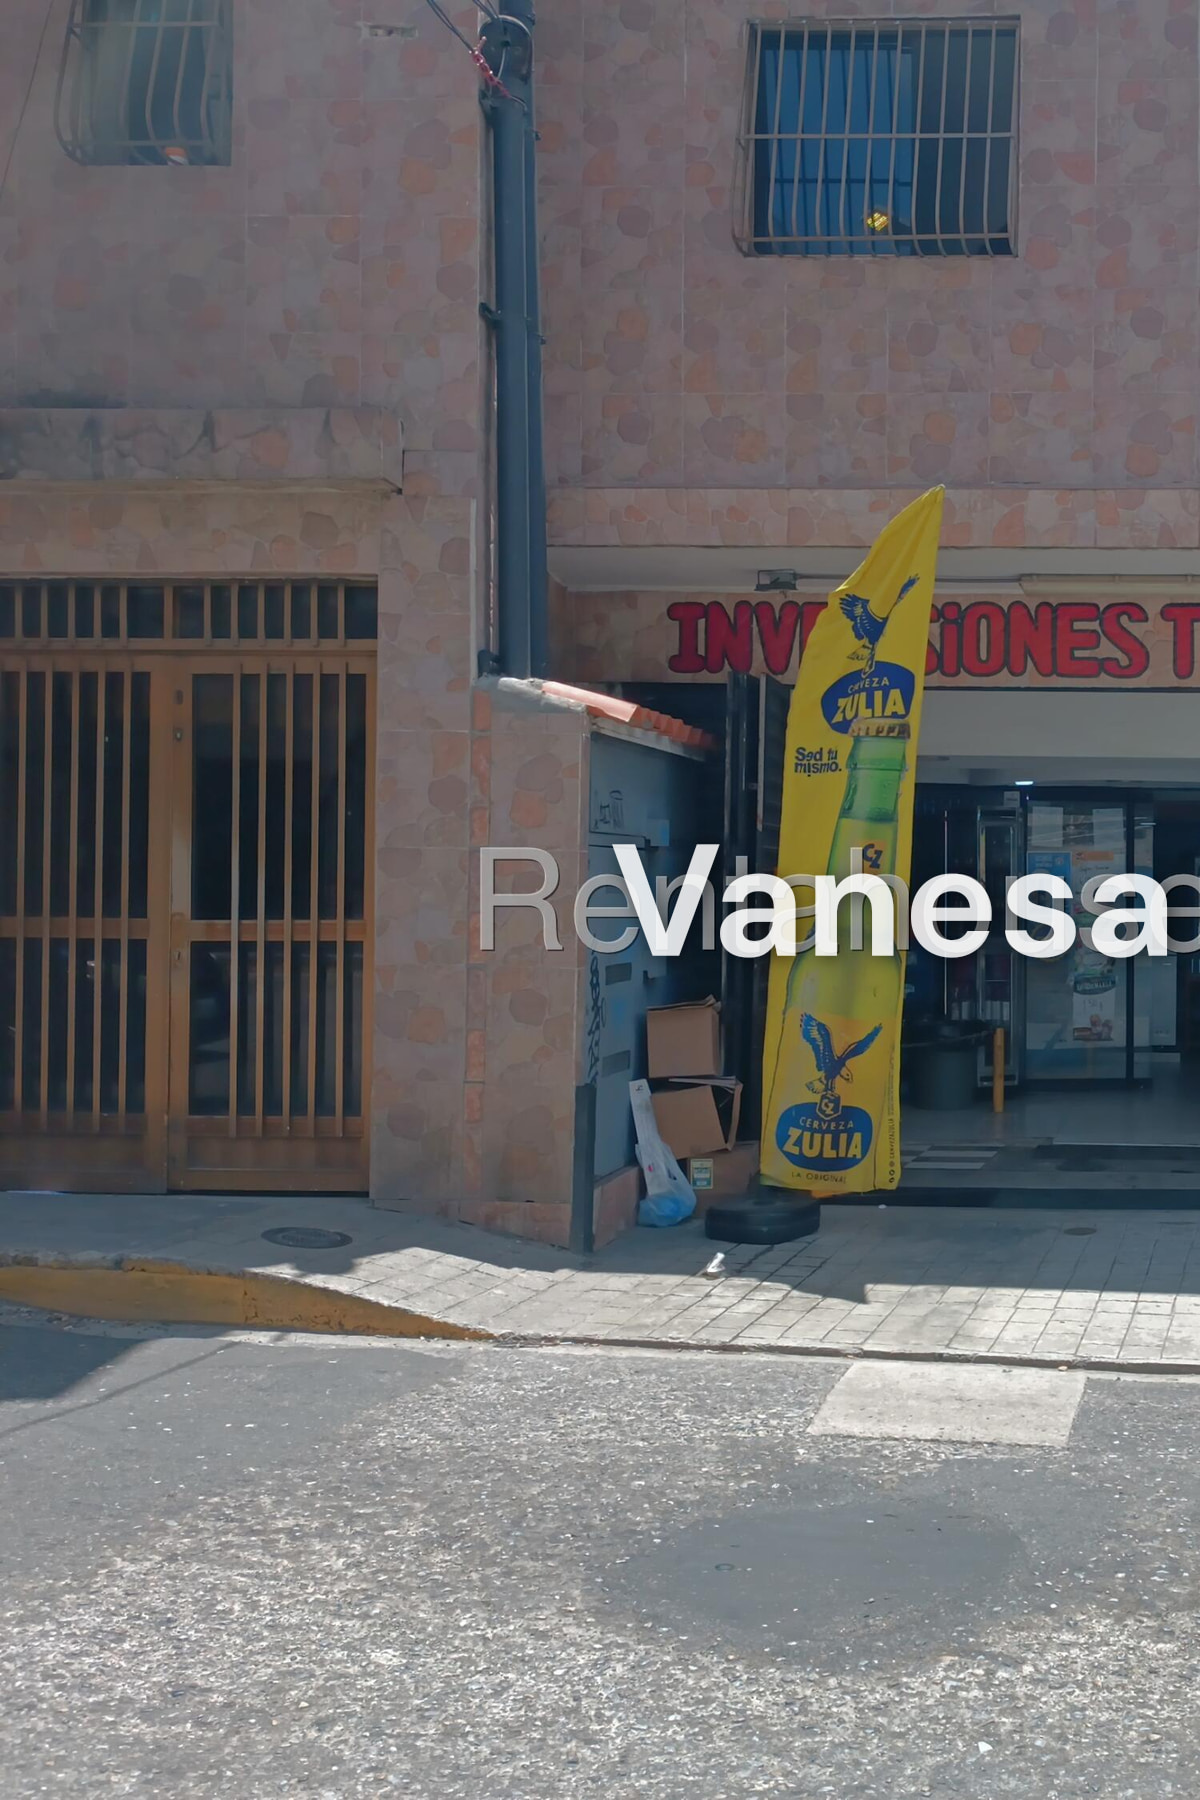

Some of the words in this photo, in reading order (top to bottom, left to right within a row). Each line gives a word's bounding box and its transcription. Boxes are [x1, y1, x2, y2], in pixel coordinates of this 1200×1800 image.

[831, 688, 907, 724] ZULIA
[799, 1116, 855, 1131] CERVEZA
[782, 1126, 862, 1159] ZULIA
